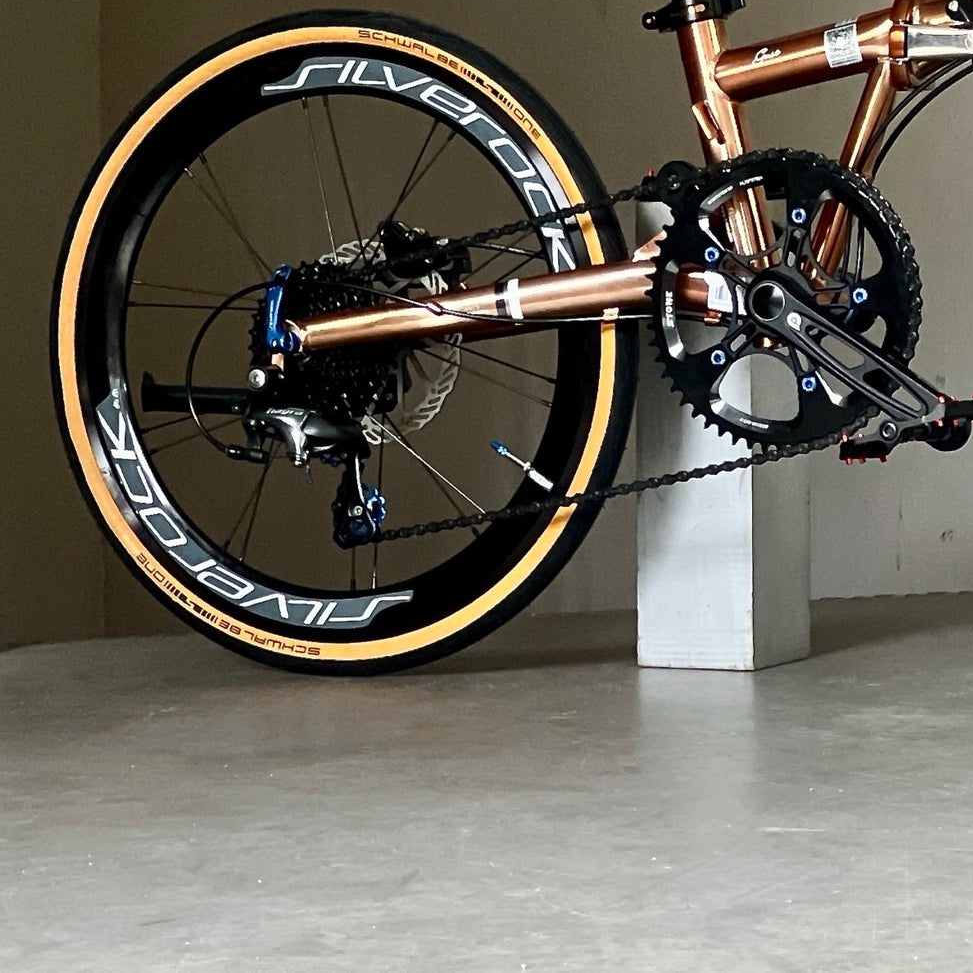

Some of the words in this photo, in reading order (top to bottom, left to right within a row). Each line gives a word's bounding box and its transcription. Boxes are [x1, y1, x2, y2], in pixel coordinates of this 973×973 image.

[357, 29, 459, 70] SCHWALBE
[513, 107, 542, 140] ONE
[136, 552, 165, 585] ONE
[219, 617, 321, 656] SCHWALBE
